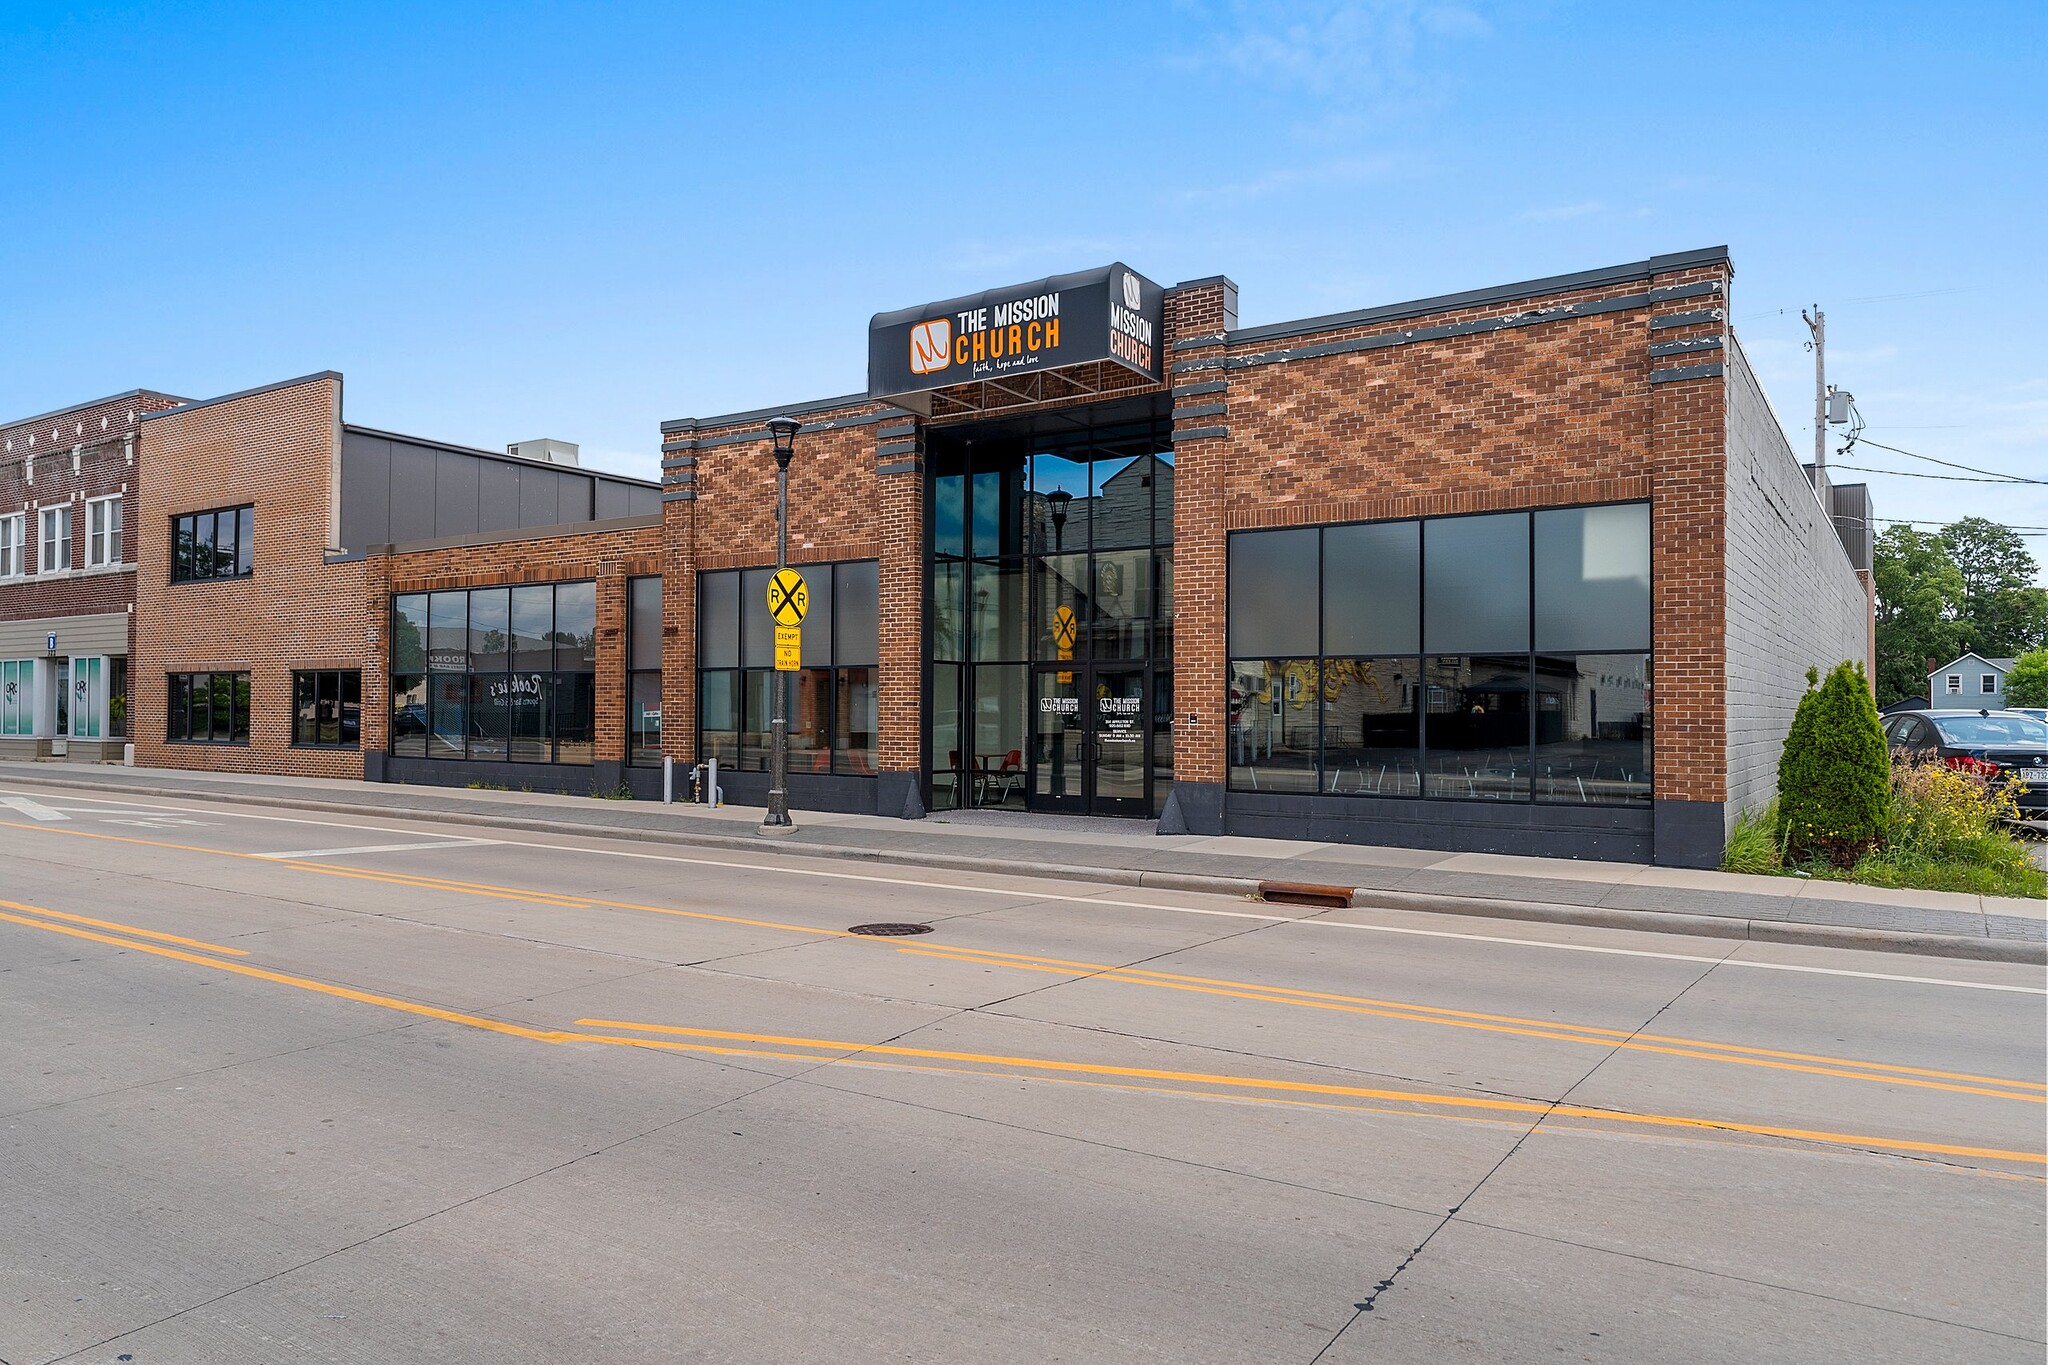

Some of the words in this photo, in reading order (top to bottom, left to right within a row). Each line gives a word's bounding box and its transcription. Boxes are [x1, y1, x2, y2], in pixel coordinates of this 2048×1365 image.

[957, 308, 987, 334] THE
[995, 292, 1060, 328] MISSION
[1110, 301, 1152, 347] MISSION
[955, 318, 1060, 365] CHURCH
[1110, 328, 1152, 372] CHURCH
[996, 358, 1011, 372] hope
[1012, 356, 1026, 367] and
[1026, 354, 1040, 364] love
[777, 632, 798, 641] EXEMPT
[777, 659, 788, 667] TRAIN
[1052, 703, 1079, 711] CHURCH
[1112, 703, 1140, 711] CHURCH
